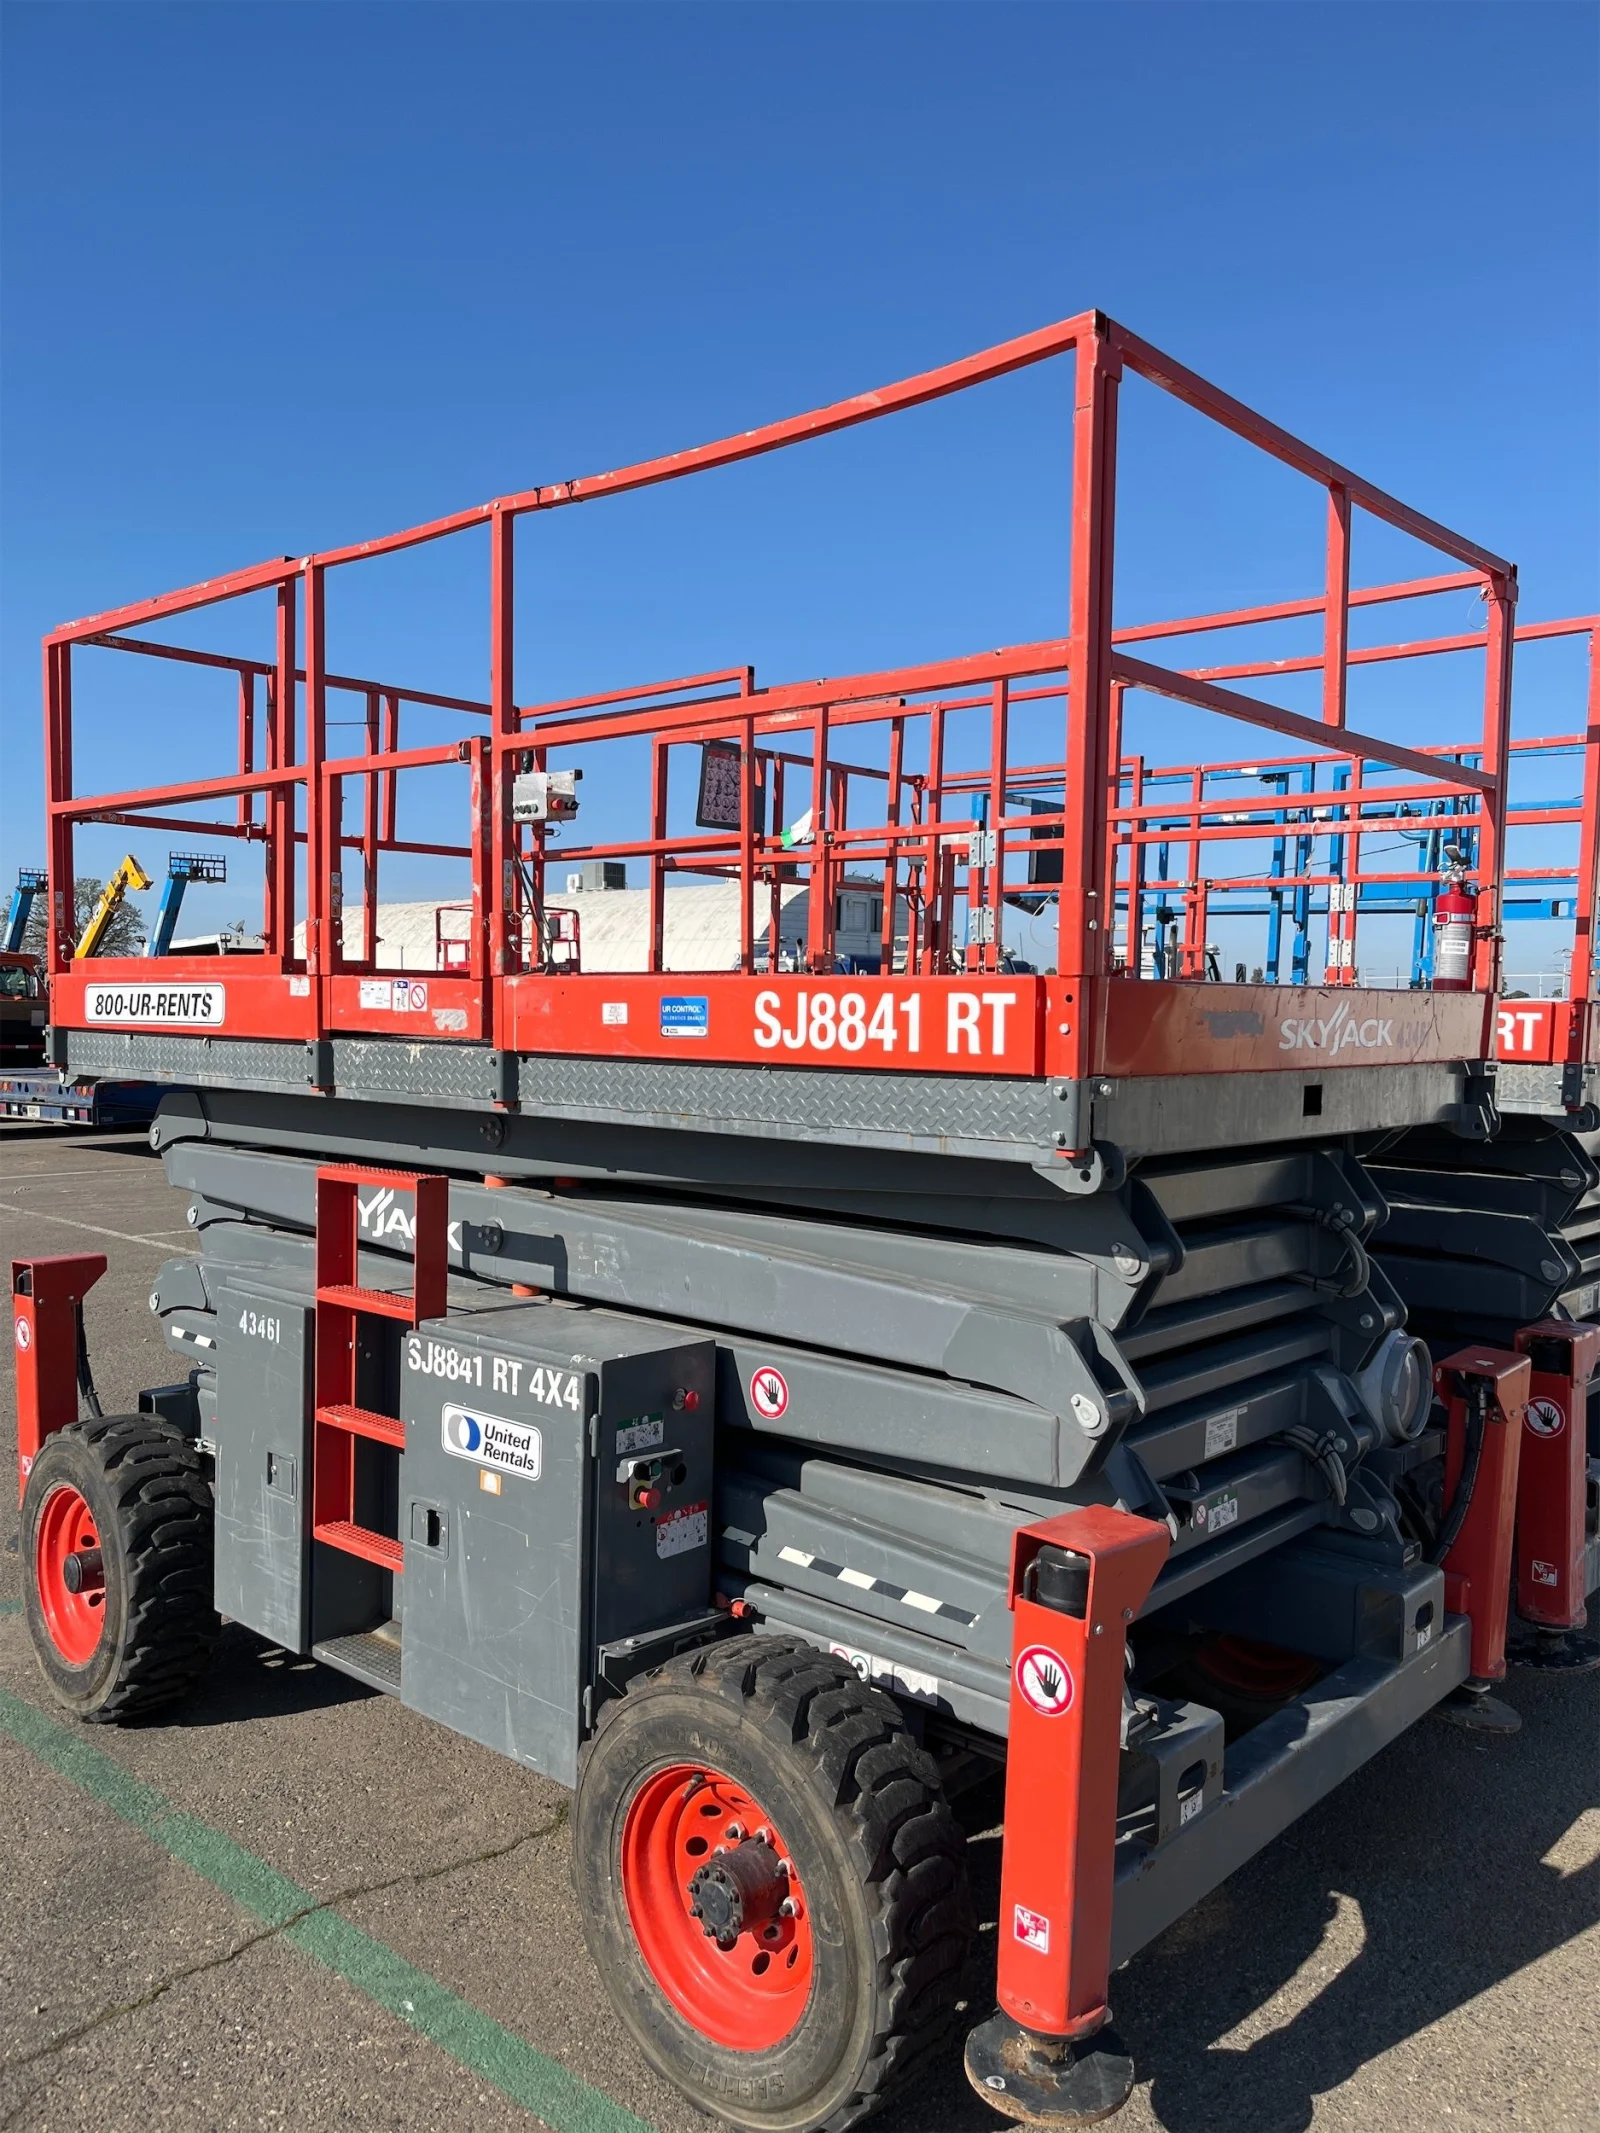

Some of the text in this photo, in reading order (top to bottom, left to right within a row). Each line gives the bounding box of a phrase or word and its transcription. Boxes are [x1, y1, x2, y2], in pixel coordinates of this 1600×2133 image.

[95, 992, 213, 1018] 800-UR-RENTS
[662, 1005, 701, 1013] UR CONTROL
[753, 990, 1017, 1055] SJ8841 RT
[1278, 1000, 1394, 1056] SKYJACK
[1497, 1011, 1543, 1051] RT
[239, 1309, 280, 1344] 43461
[408, 1338, 580, 1412] SJ8841 RT 4X4
[484, 1423, 531, 1451] United
[483, 1441, 535, 1471] Rentals
